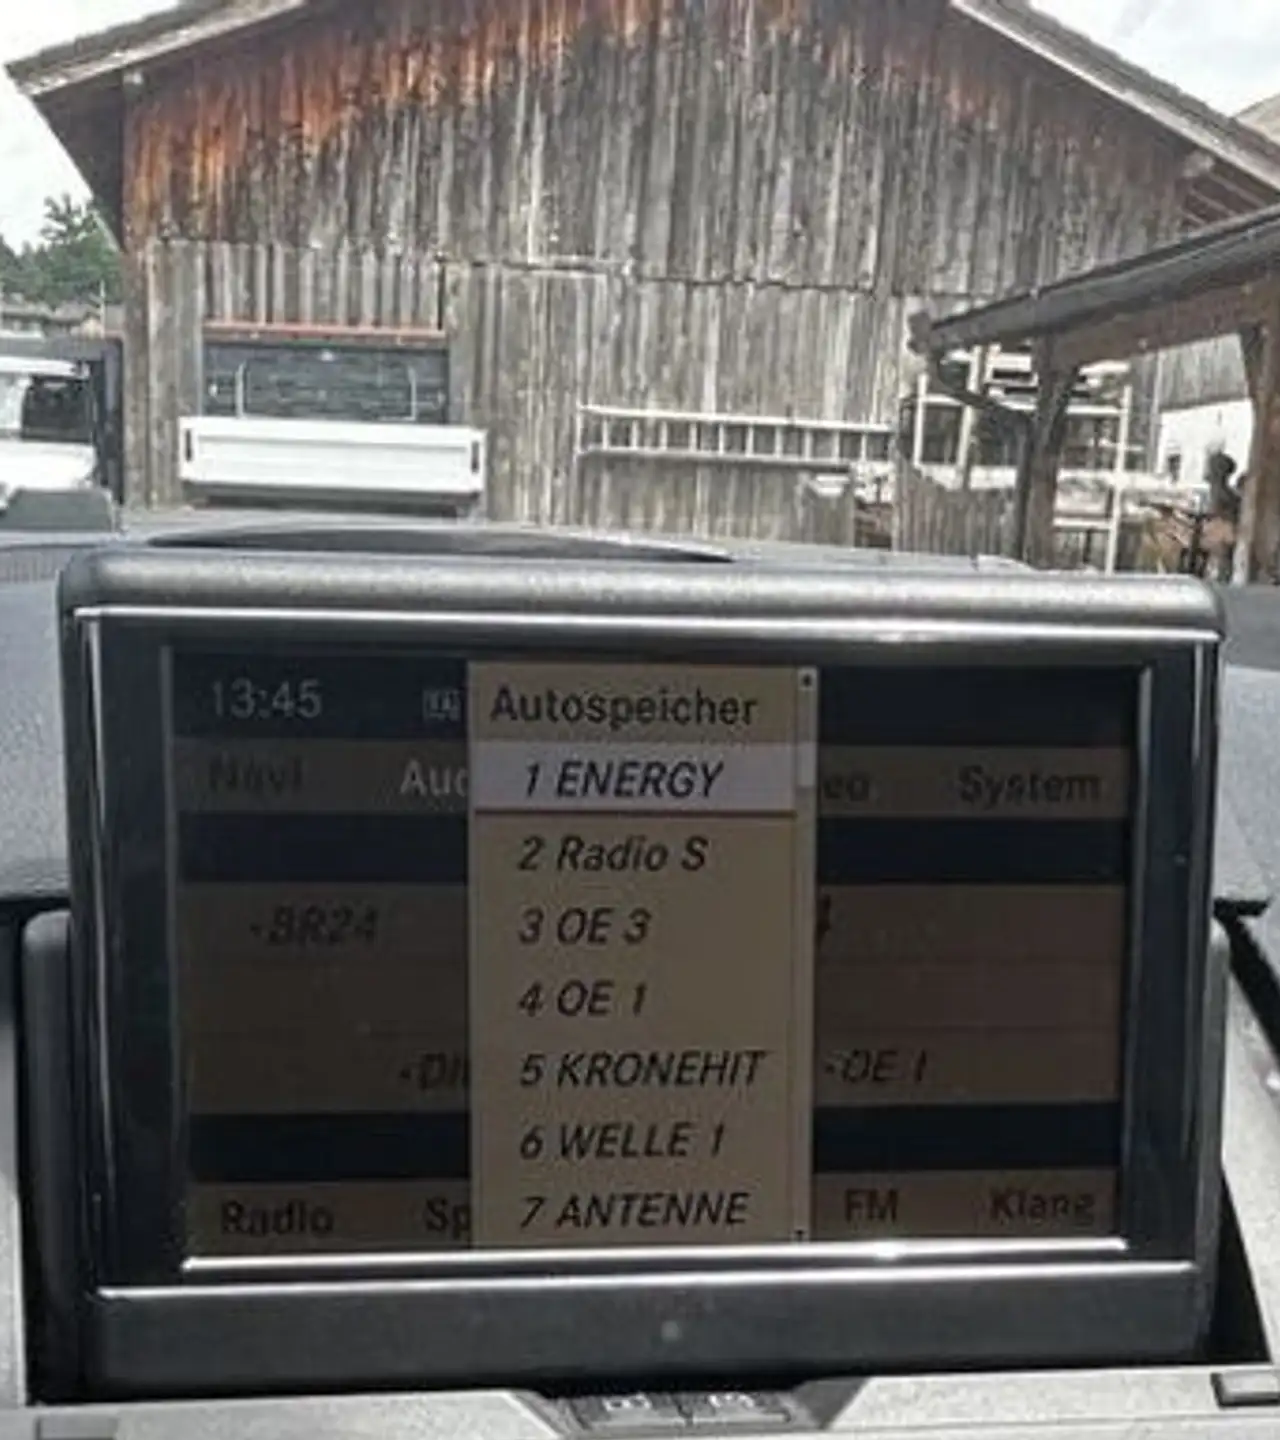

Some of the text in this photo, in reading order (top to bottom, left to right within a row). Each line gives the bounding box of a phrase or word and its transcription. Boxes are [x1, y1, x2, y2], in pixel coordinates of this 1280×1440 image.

[211, 678, 323, 719] 13:45
[489, 684, 759, 731] Autospeicher
[209, 755, 303, 795] Navi
[525, 760, 725, 798] 1 ENERGY
[957, 764, 1103, 811] System
[517, 834, 710, 872] 2 Radio S
[519, 907, 652, 945] 3 OE 3
[517, 979, 648, 1017] 4 OE 1
[520, 1050, 767, 1087] 5 KRONEHIT
[519, 1122, 725, 1160] 6 WELLE 1
[222, 1199, 335, 1236] Radio
[520, 1193, 750, 1229] 7 ANTENNE
[843, 1189, 900, 1222] FM
[989, 1188, 1096, 1227] Klang
